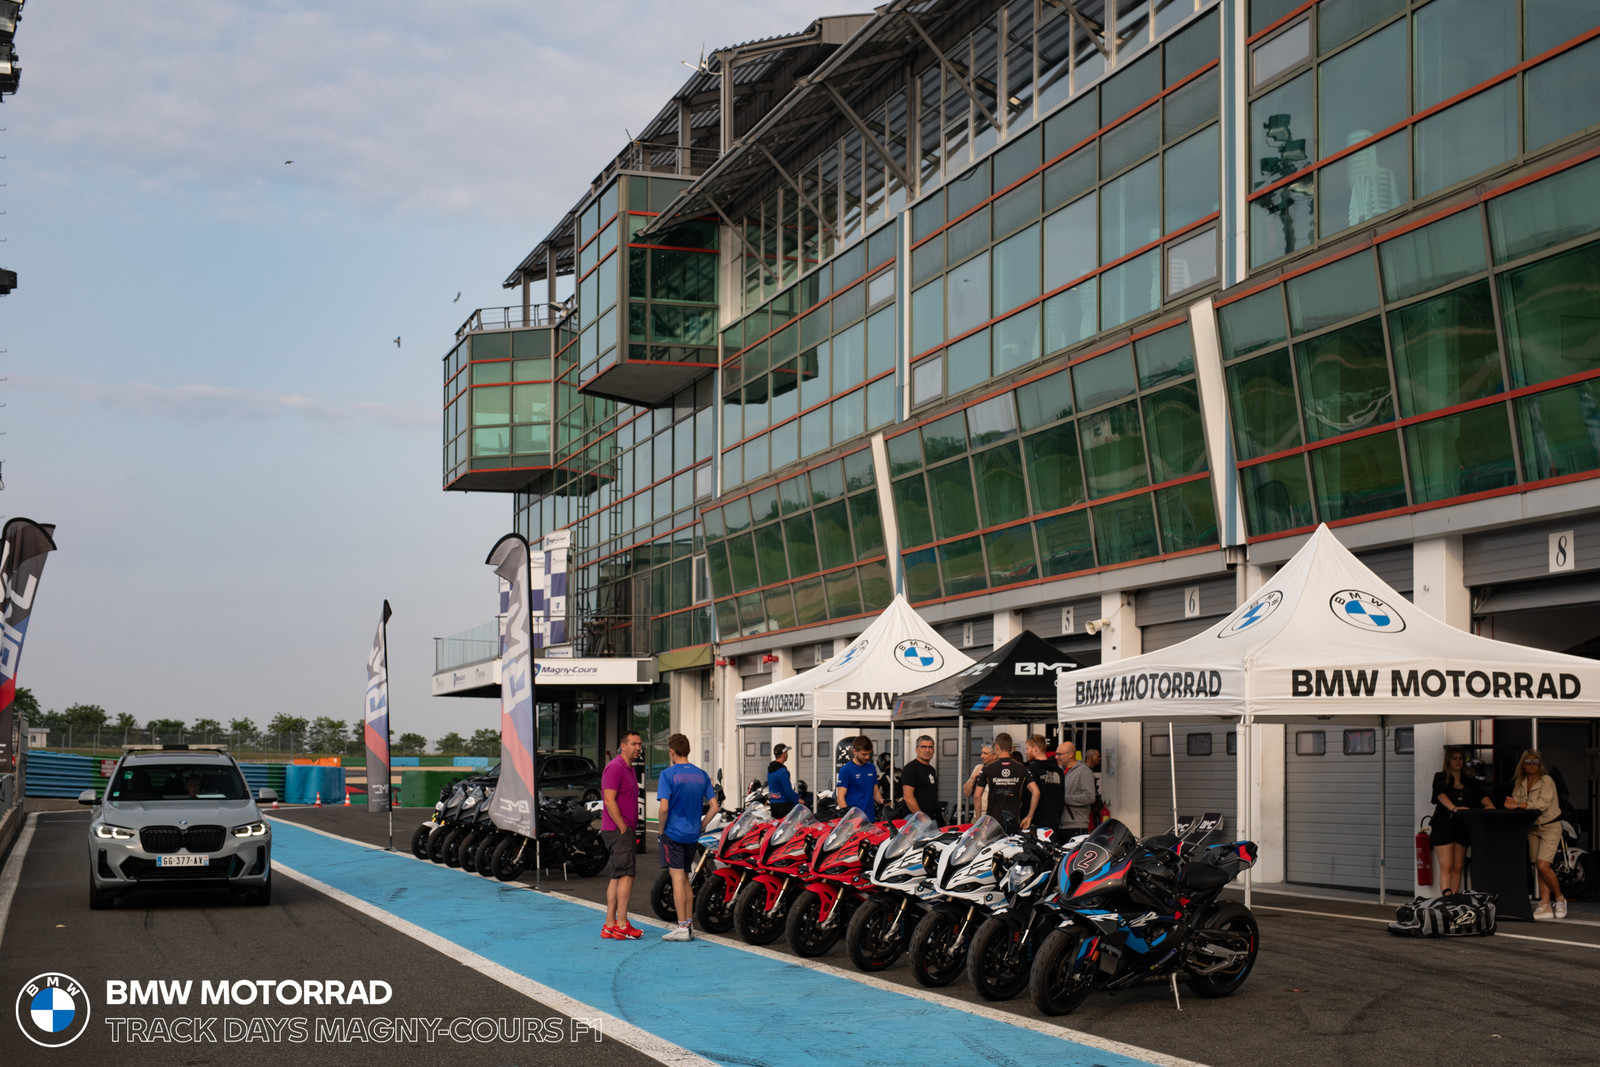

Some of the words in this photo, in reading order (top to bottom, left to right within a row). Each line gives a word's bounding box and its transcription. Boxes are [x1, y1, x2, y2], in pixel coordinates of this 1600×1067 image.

[1555, 535, 1568, 567] 8
[1188, 590, 1196, 614] 6
[1334, 592, 1384, 607] BMW
[1064, 610, 1071, 631] 5
[541, 666, 598, 675] Magny-Cours
[1075, 676, 1116, 705] BMW
[1119, 670, 1222, 701] MOTORRAD
[1291, 669, 1379, 697] BMW
[1391, 669, 1581, 700] MOTORRAD
[742, 696, 761, 714] BMW
[762, 693, 805, 713] MOTORRAD
[1077, 850, 1098, 869] 2
